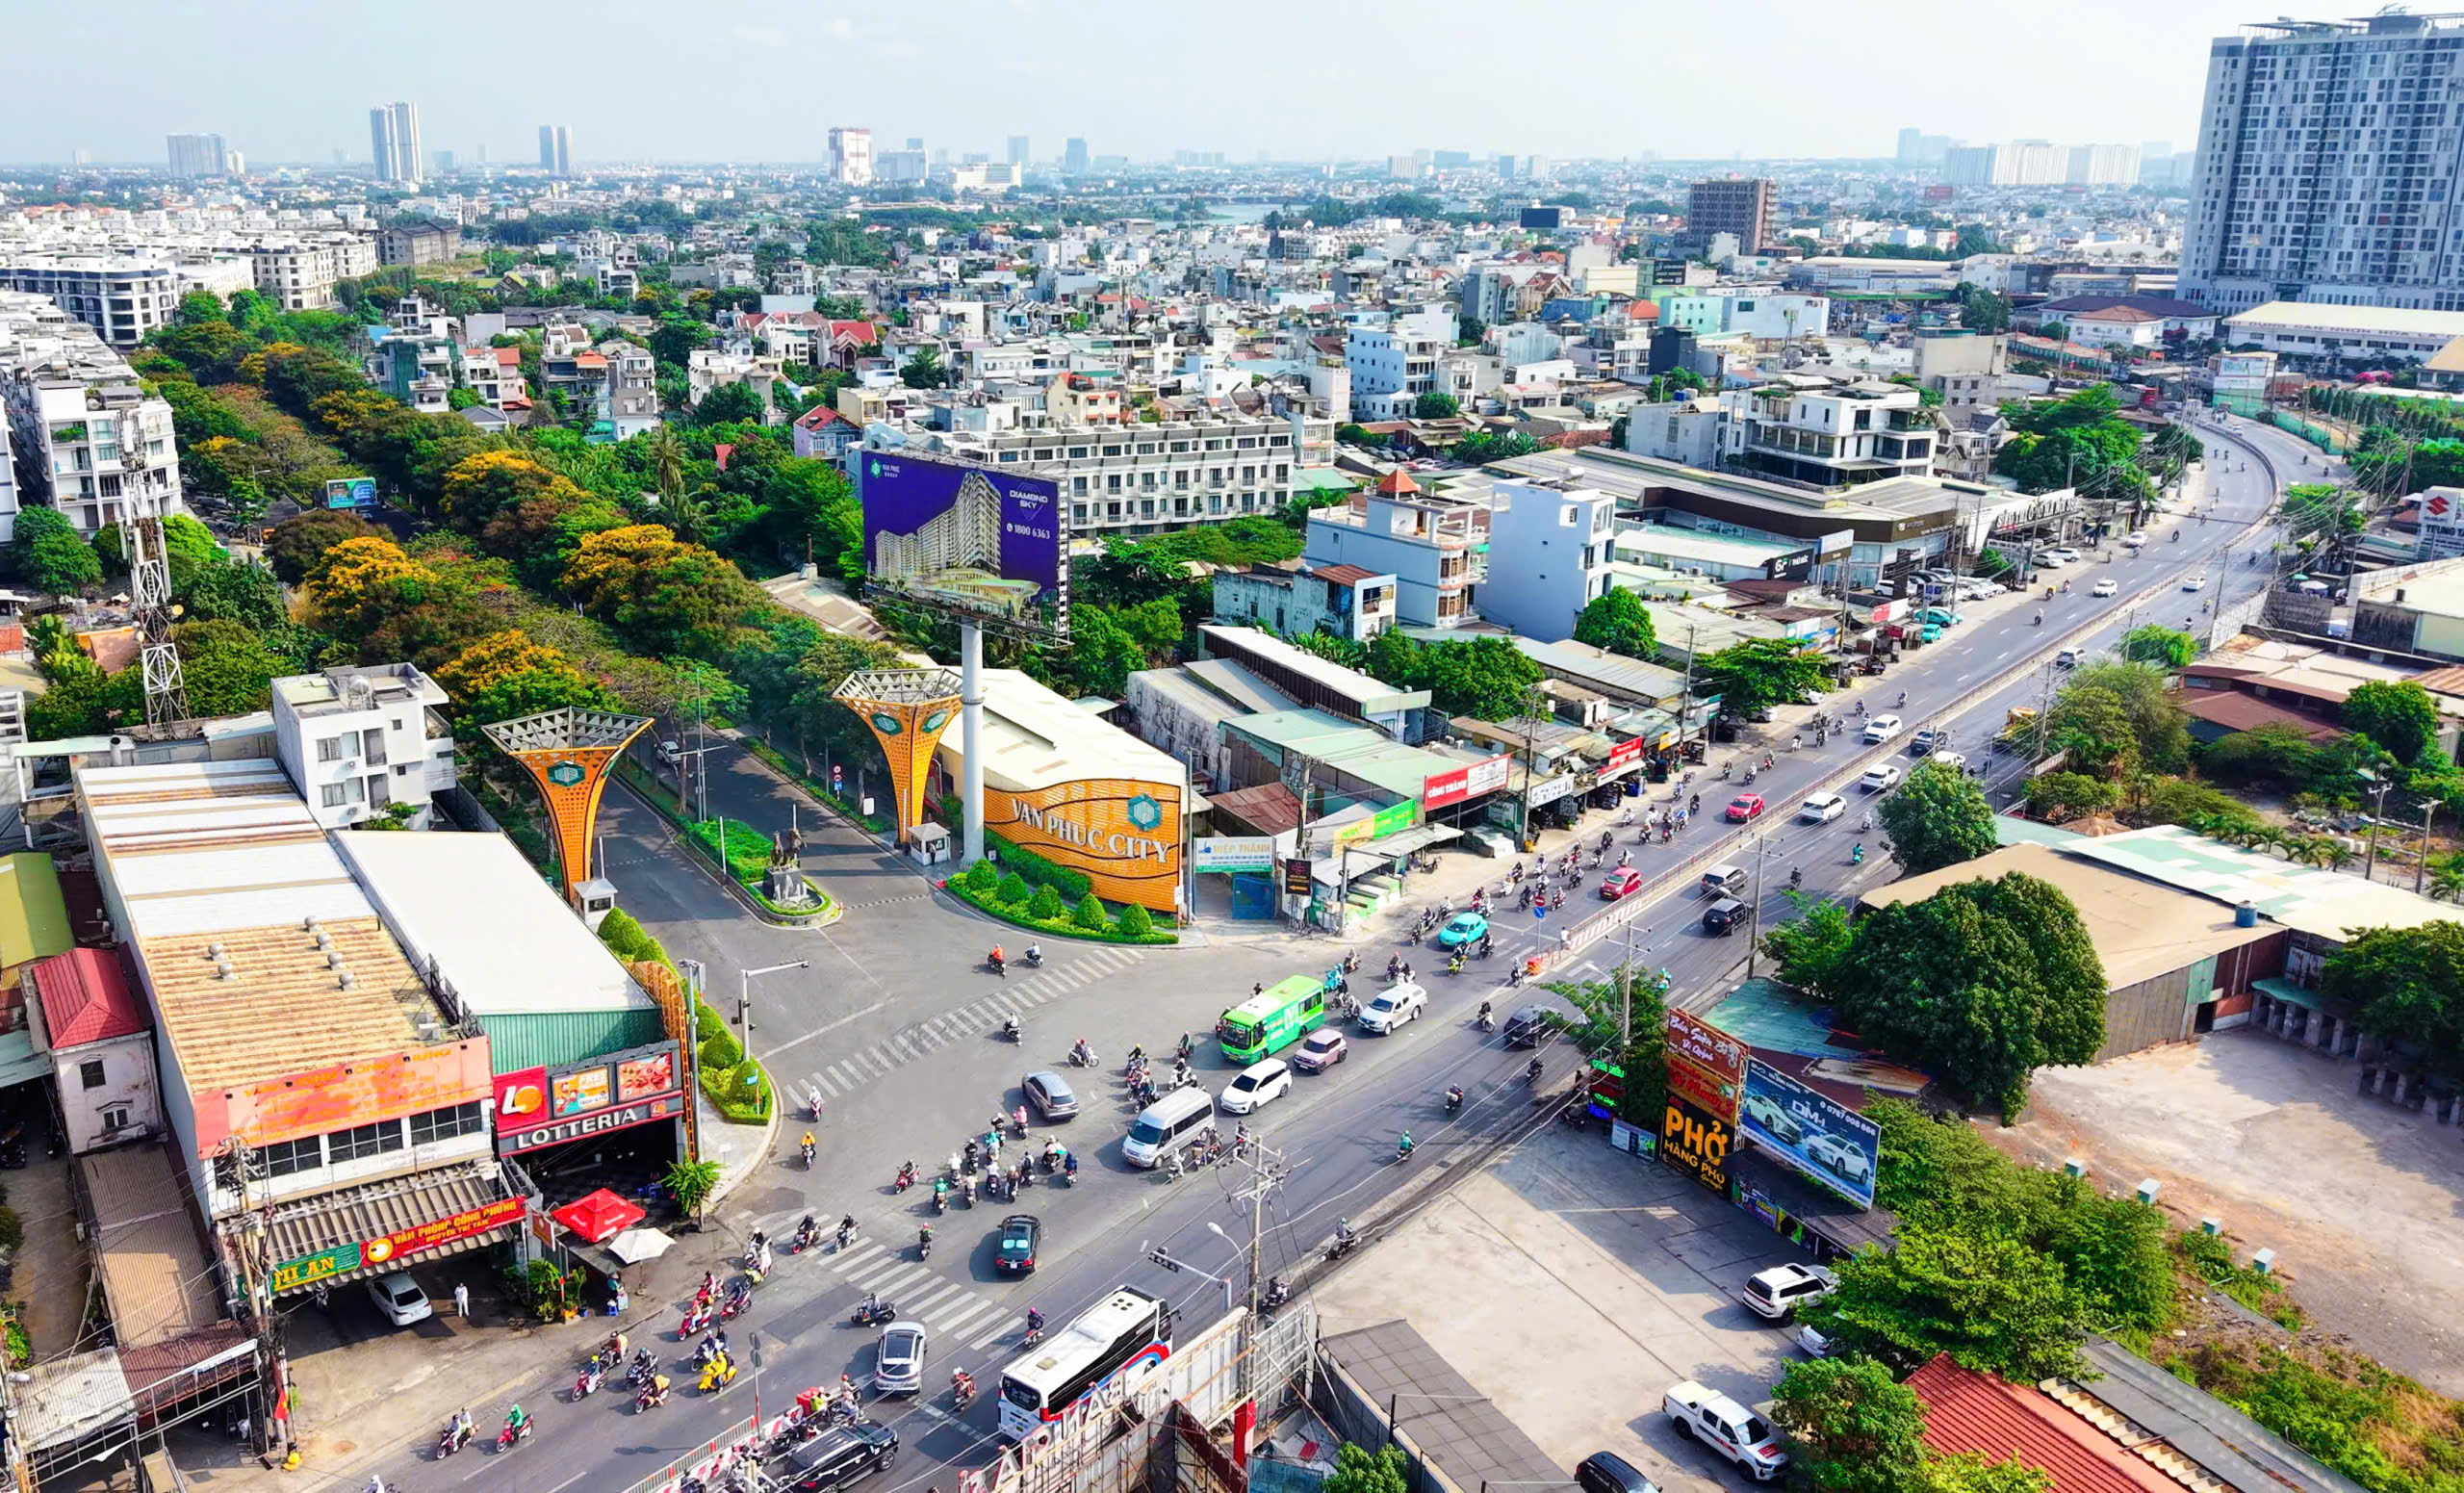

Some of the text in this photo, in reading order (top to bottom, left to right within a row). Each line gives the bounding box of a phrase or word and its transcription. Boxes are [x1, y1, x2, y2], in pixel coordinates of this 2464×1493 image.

[1009, 489, 1048, 503] DIAMOND
[1019, 500, 1038, 509] SKY
[1014, 524, 1051, 539] 1800 6363
[1011, 797, 1172, 863] VAN PHUC CITY
[517, 1108, 638, 1148] LOTTERIA
[1665, 1106, 1729, 1166] PHỞ
[1664, 1139, 1699, 1167] HÀNG
[453, 1211, 481, 1227] CÔNG
